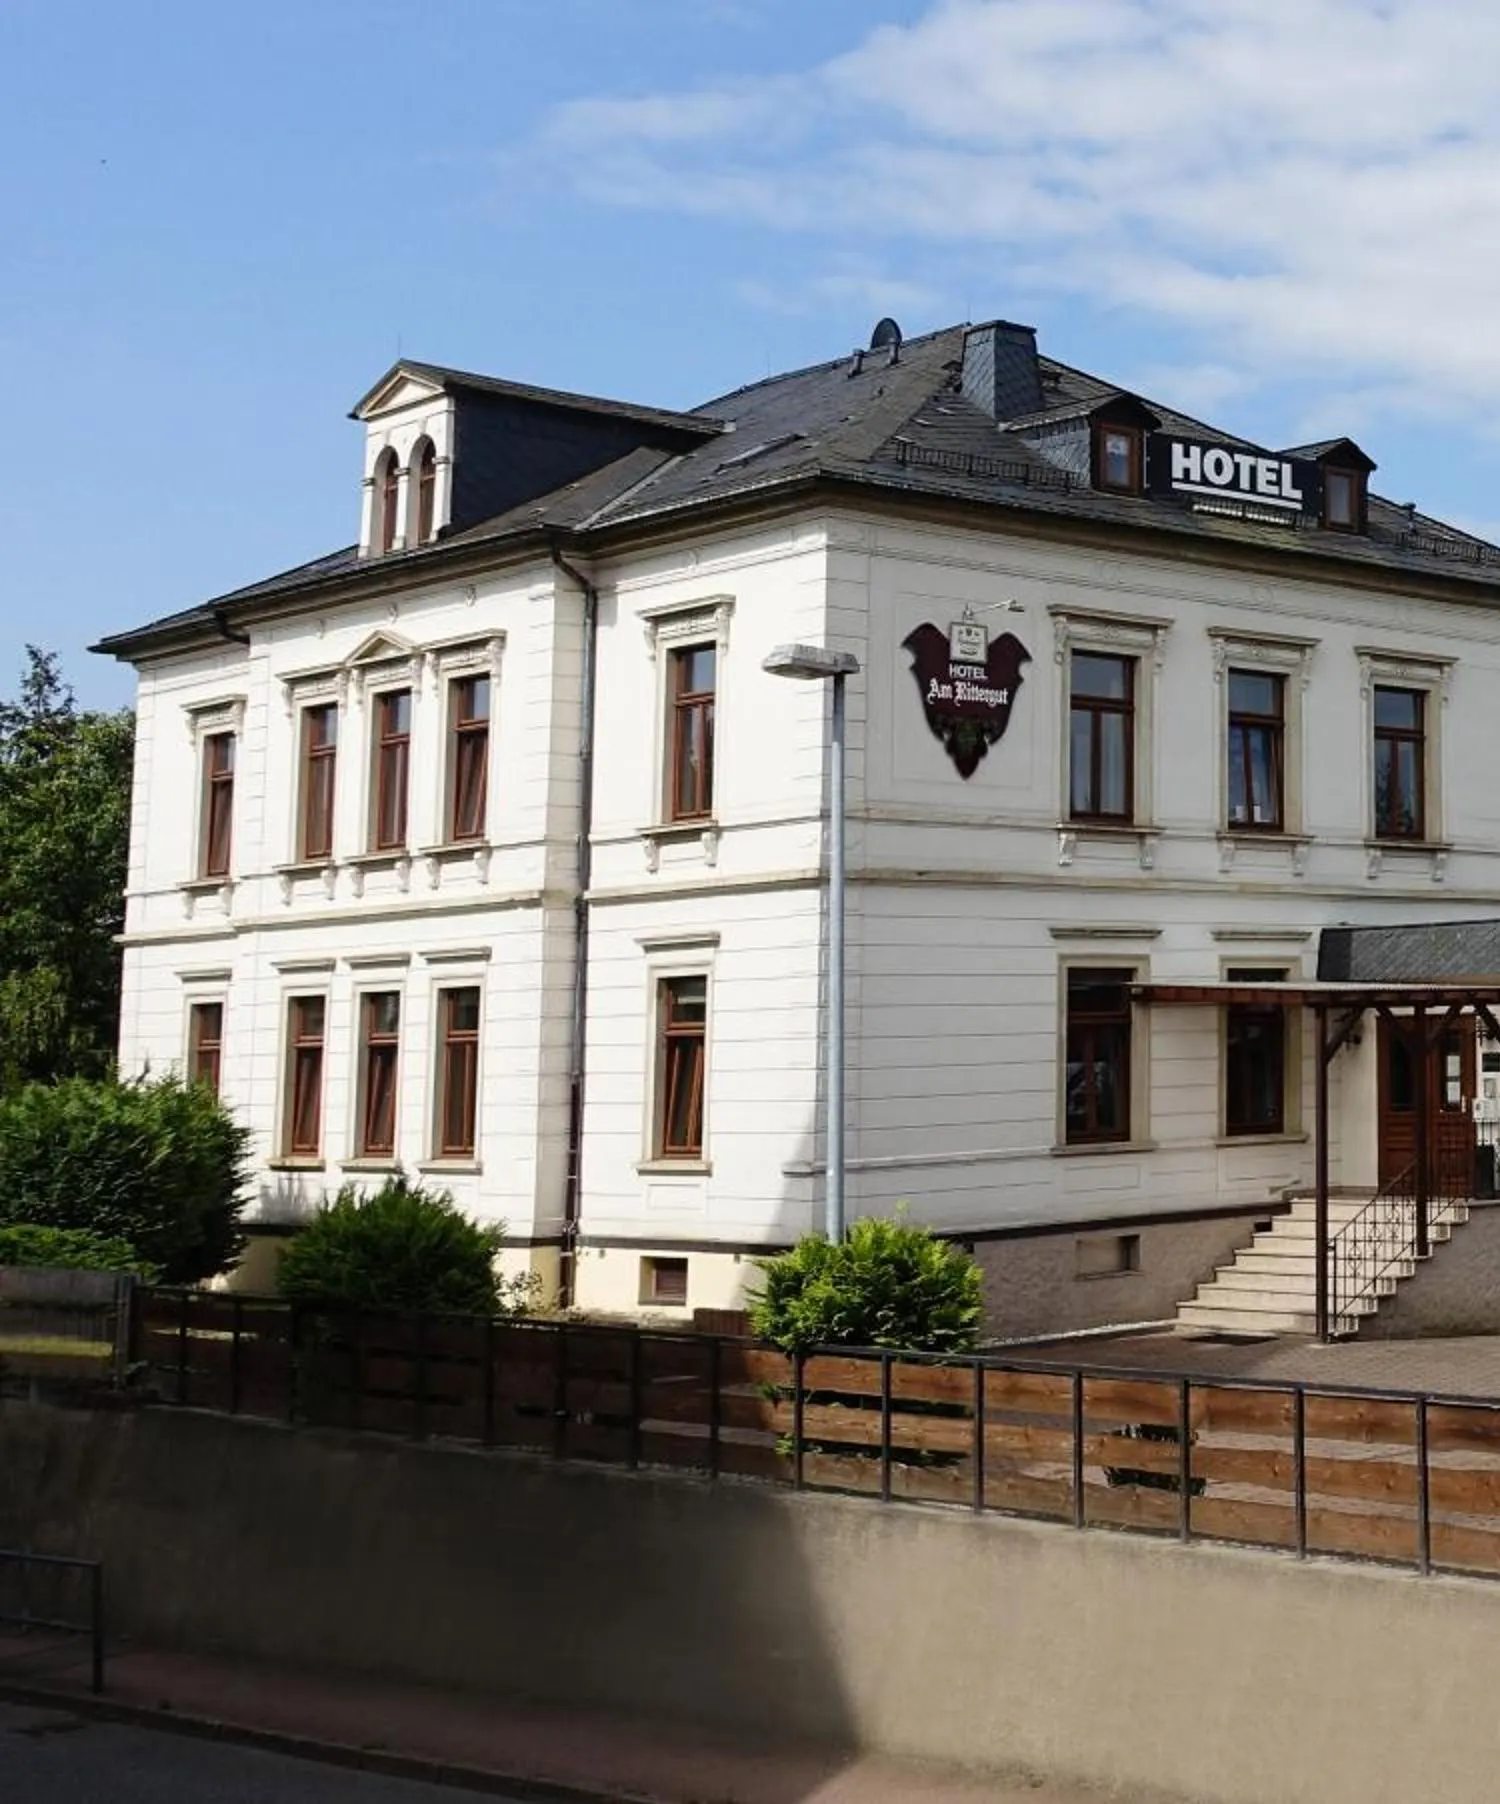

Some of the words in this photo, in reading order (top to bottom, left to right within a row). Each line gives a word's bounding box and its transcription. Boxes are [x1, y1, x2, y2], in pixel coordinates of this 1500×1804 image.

[1171, 442, 1303, 500] HOTEL
[949, 663, 988, 680] HOTEL
[927, 677, 953, 704] Am
[953, 680, 1009, 707] Rittergut
